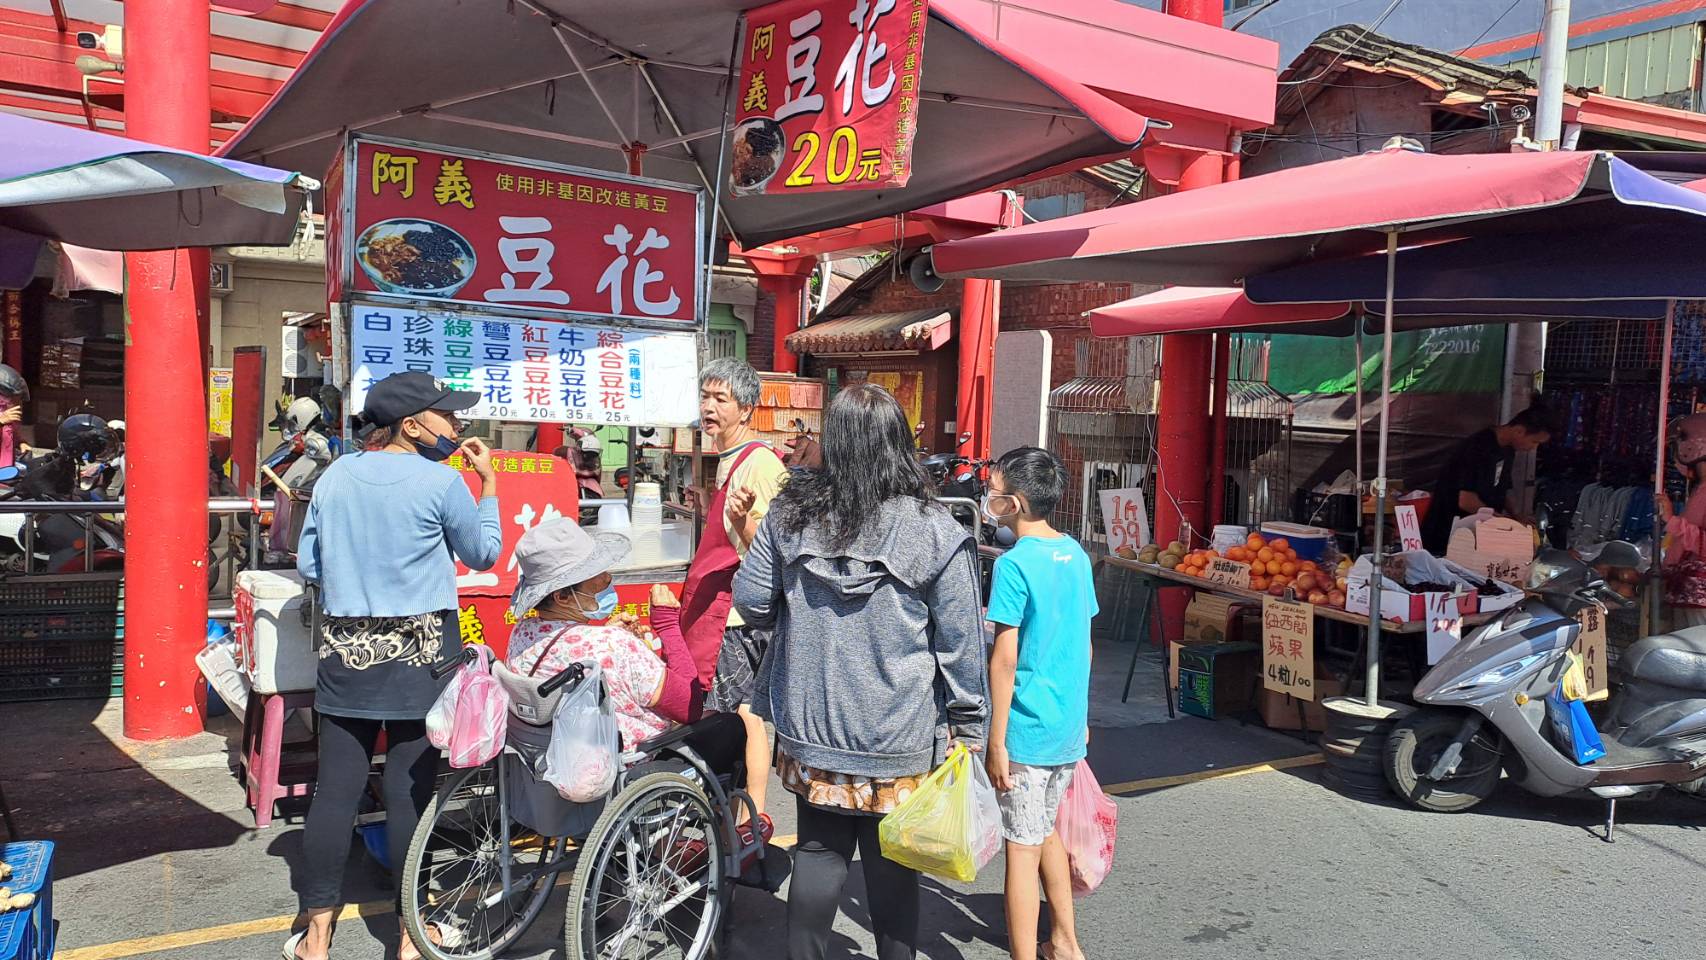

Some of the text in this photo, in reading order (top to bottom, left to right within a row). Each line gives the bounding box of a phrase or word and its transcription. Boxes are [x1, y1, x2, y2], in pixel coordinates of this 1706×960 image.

[743, 23, 776, 112] 阿義
[774, 0, 897, 122] 豆花
[372, 152, 474, 208] 阿義
[784, 126, 881, 188] 20元
[496, 172, 669, 213] 使用非基因改造黃豆
[483, 216, 681, 315] 豆花
[521, 324, 551, 406] 紅豆豆花
[558, 328, 587, 408] 牛奶豆花
[596, 330, 625, 410] 綜合豆花
[1112, 496, 1138, 524] 1斤
[1112, 520, 1140, 553] 29
[1264, 609, 1308, 637] 紐西蘭
[1268, 634, 1304, 661] 蘋果
